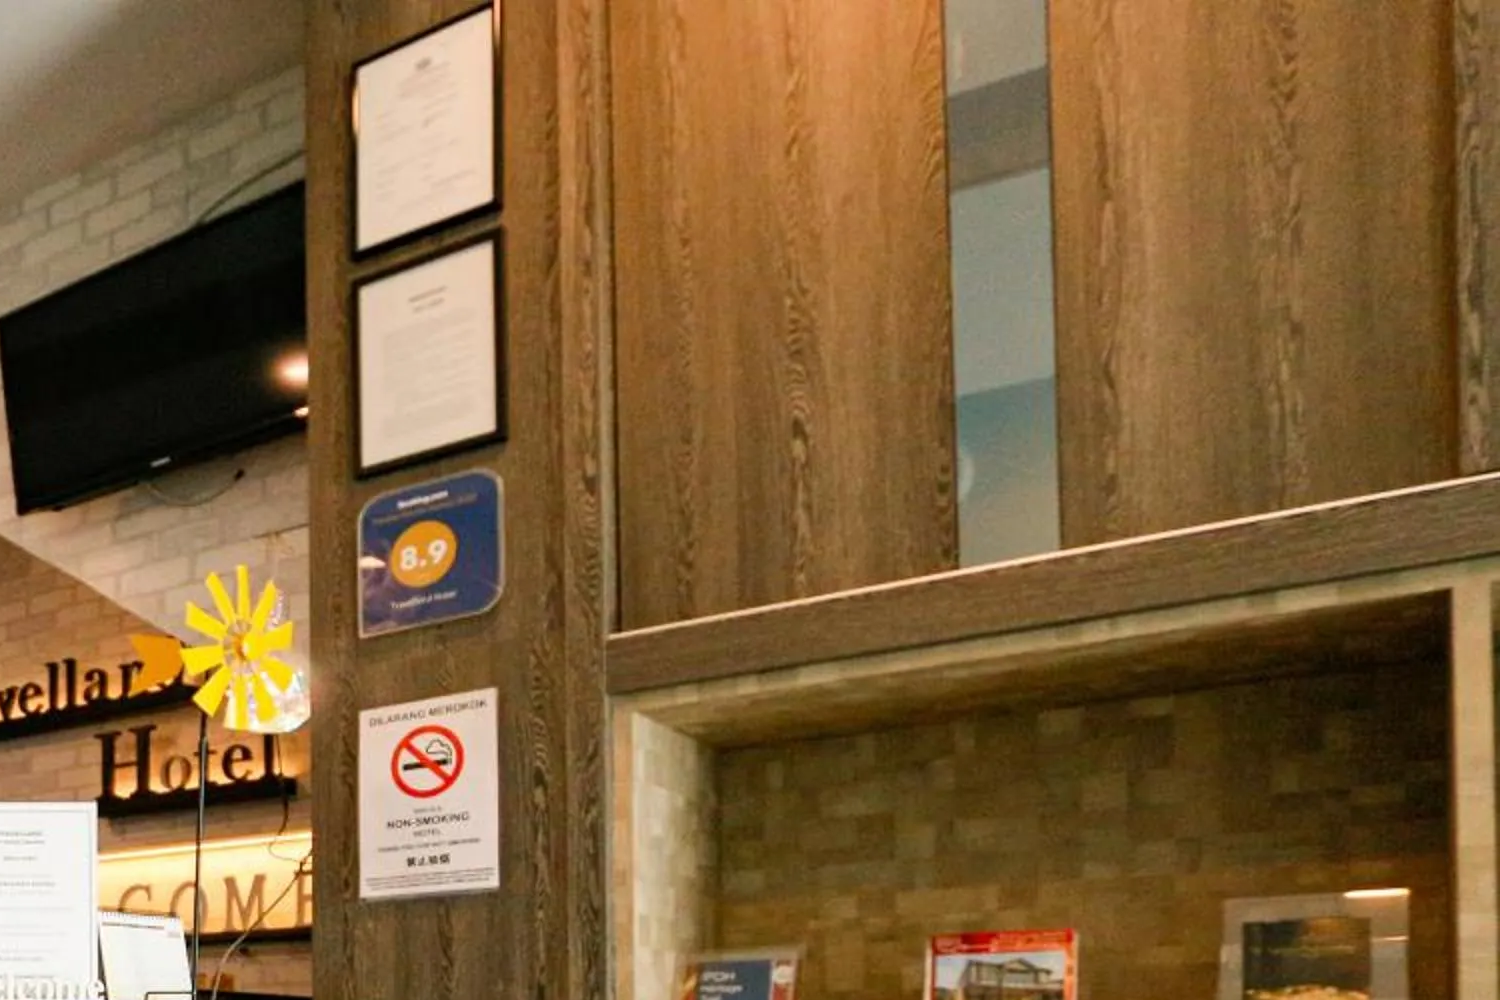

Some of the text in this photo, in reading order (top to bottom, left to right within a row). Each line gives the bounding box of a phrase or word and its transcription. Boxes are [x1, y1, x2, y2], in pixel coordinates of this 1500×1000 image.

[401, 539, 447, 571] 8.9
[94, 723, 276, 799] Hotel
[387, 810, 470, 829] NON-SMOKING
